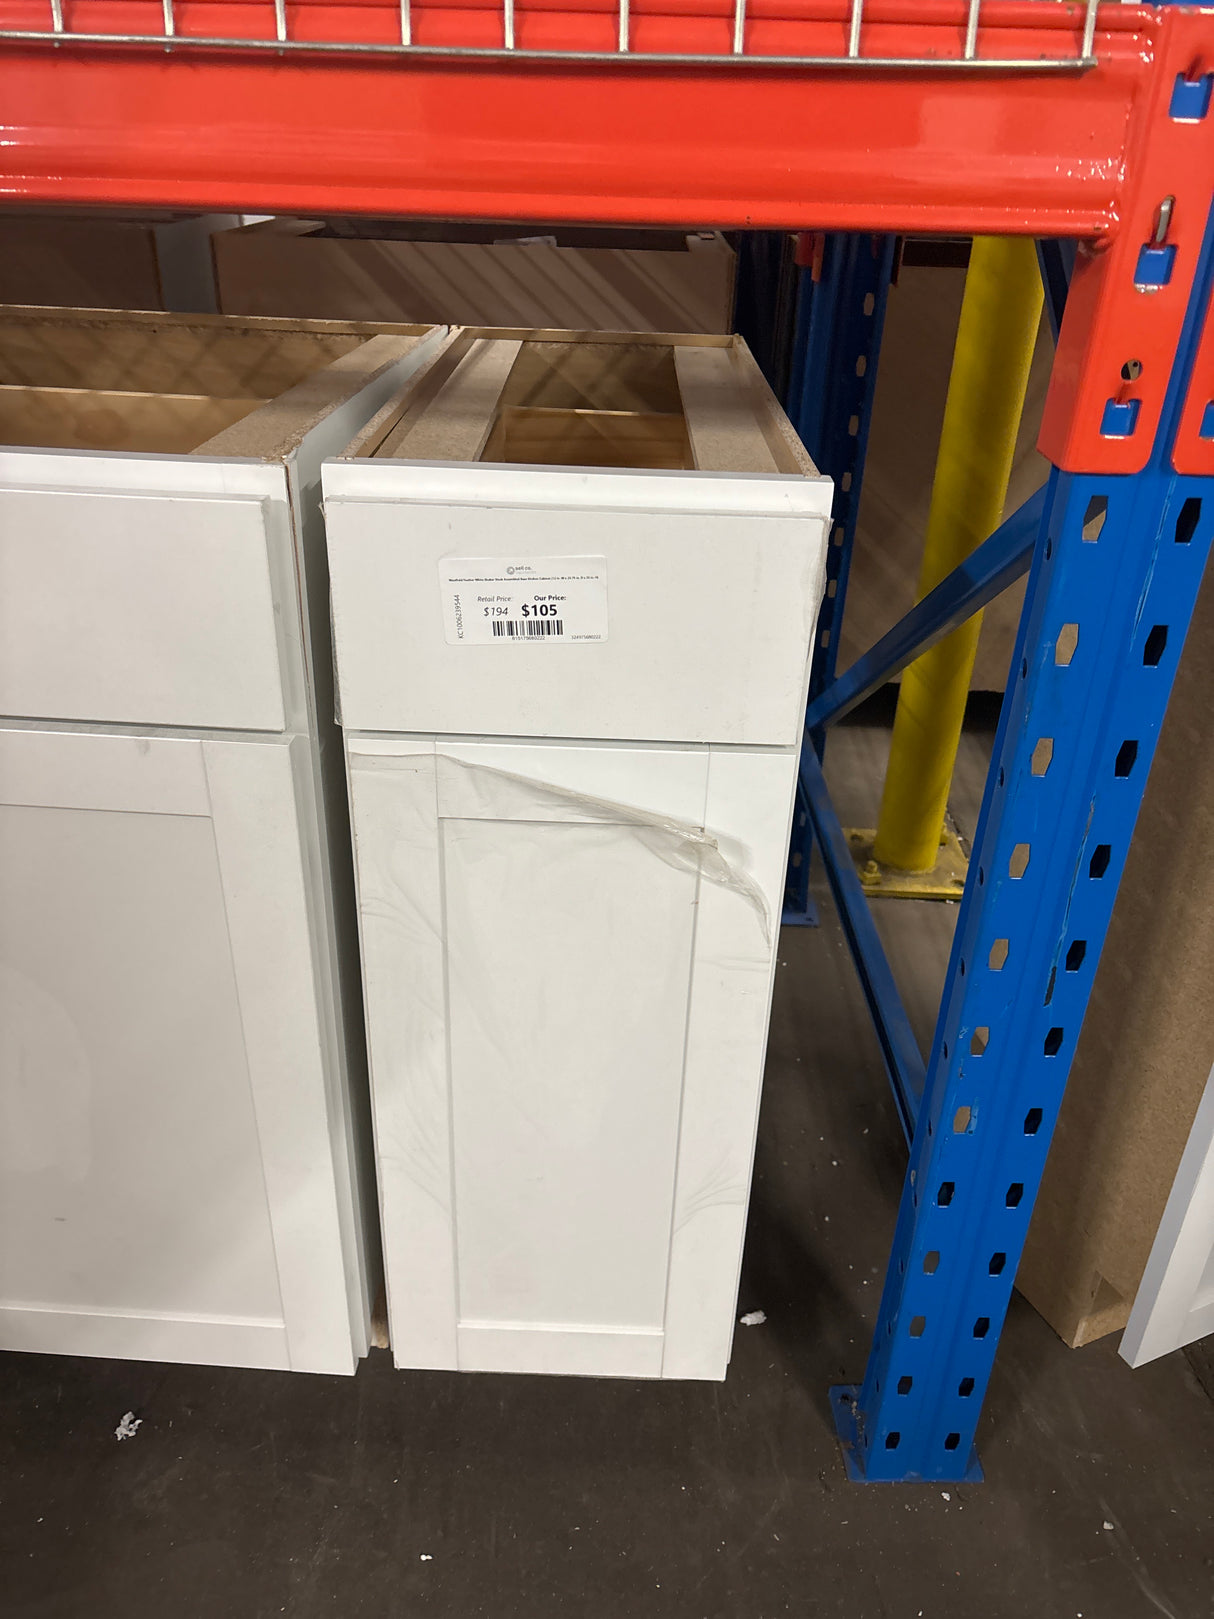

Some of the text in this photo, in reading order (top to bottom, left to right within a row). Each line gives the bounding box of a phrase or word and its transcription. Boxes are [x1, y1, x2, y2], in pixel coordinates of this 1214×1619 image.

[548, 594, 567, 602] Price:
[483, 606, 509, 617] $194
[521, 603, 558, 617] $105
